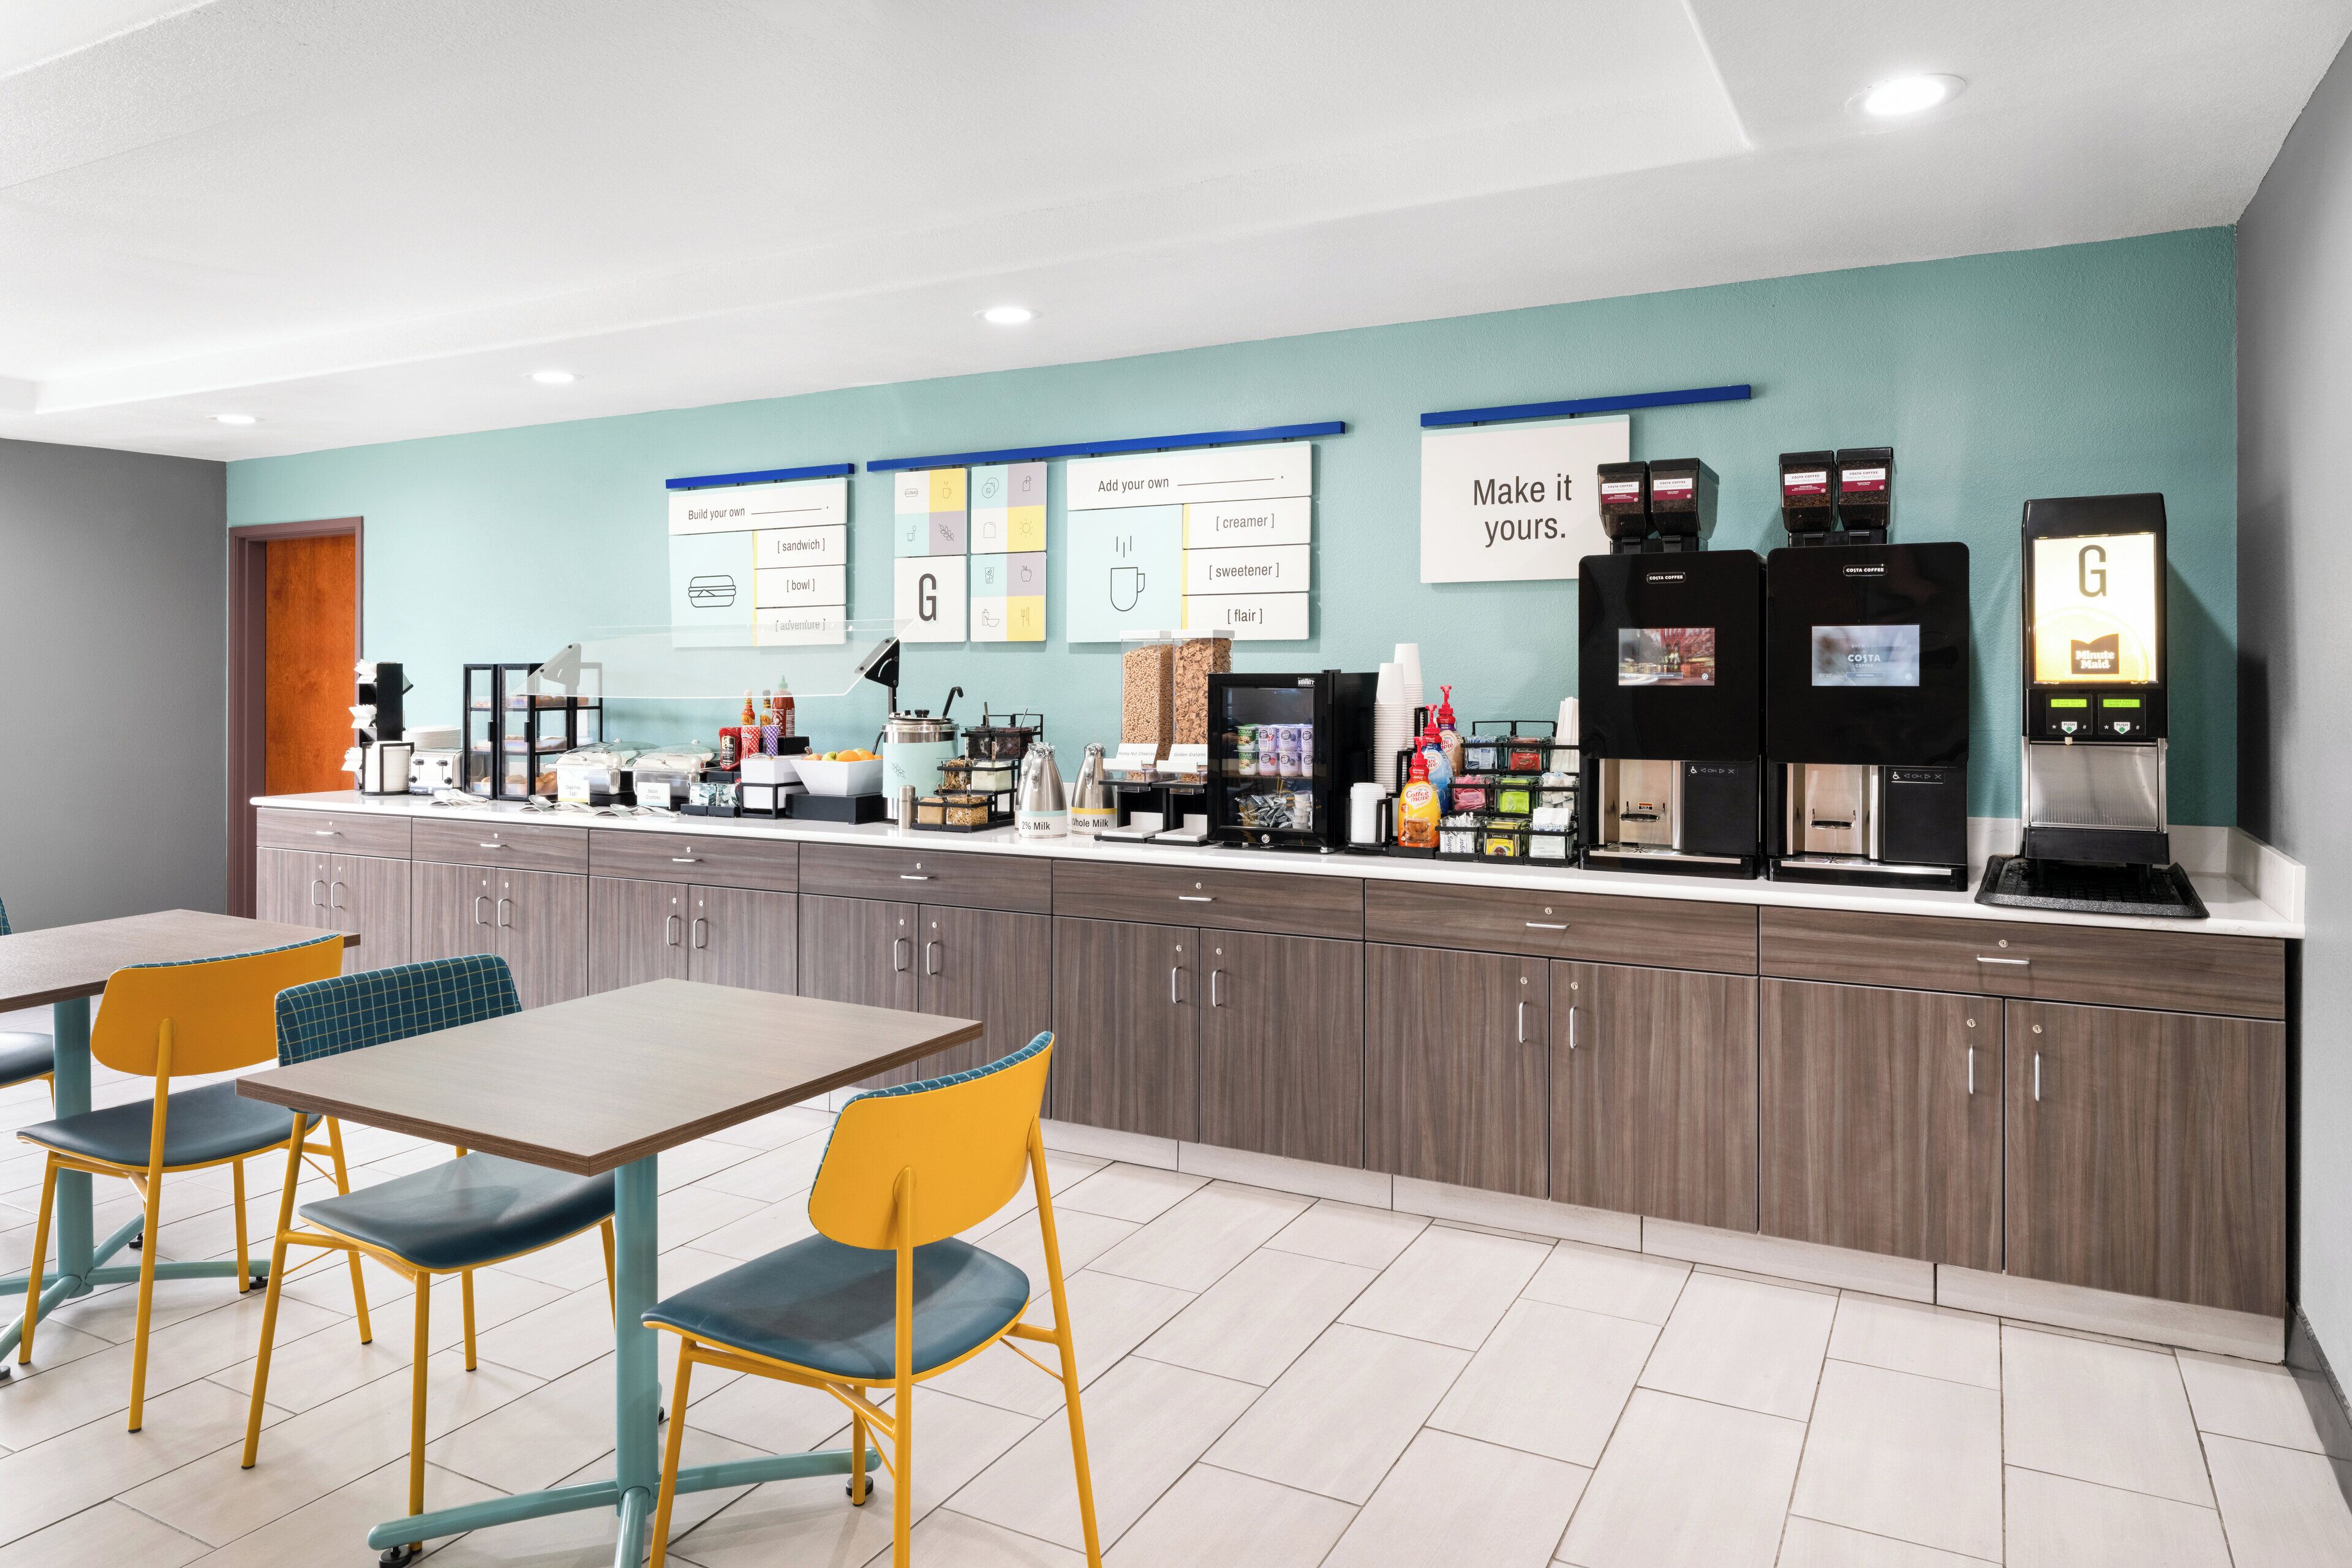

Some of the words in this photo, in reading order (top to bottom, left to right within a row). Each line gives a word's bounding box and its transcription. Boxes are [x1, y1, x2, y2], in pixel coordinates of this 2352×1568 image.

[1098, 480, 1118, 492] Add
[1122, 480, 1145, 494] your
[1148, 478, 1169, 489] own
[1474, 475, 1545, 506] Make
[1557, 473, 1572, 501] it
[688, 508, 707, 520] Build
[710, 510, 727, 521] your
[729, 508, 745, 517] own
[1223, 516, 1268, 528] creamer
[1484, 518, 1566, 548] yours.
[783, 538, 820, 551] sandwich
[1216, 565, 1273, 577] sweetener
[2078, 544, 2106, 598] G
[791, 579, 810, 590] bowl
[919, 573, 937, 622] G
[1234, 608, 1256, 622] flair
[780, 620, 820, 631] adventure
[1847, 654, 1881, 663] COSTA
[2075, 650, 2115, 660] Minute
[2081, 659, 2109, 669] Maid
[1022, 821, 1031, 830] 2%
[1033, 821, 1050, 831] Milk
[1092, 818, 1109, 827] Milk
